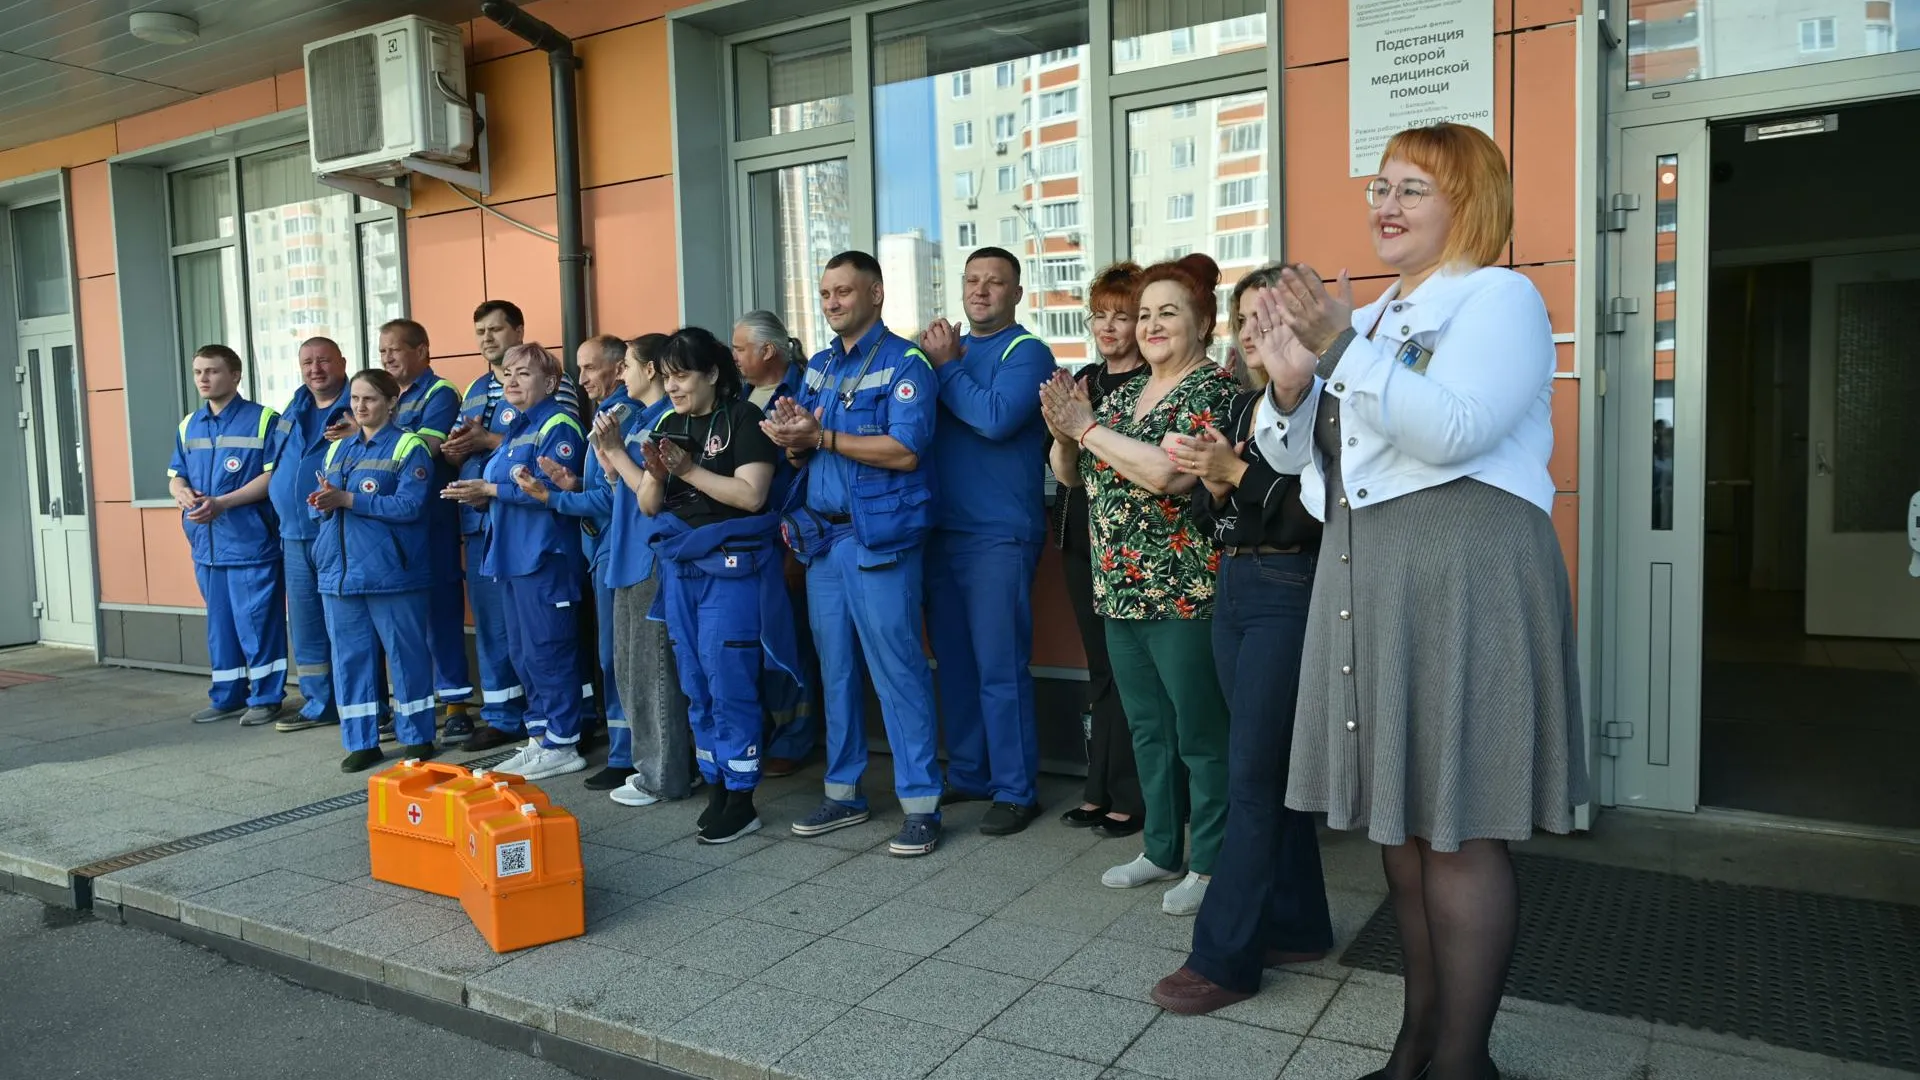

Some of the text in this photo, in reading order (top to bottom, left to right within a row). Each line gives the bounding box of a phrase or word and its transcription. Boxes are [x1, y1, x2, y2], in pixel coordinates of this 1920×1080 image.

[1376, 29, 1464, 52] Подстанция
[1393, 46, 1445, 66] скорой
[1371, 60, 1470, 86] медицинской
[1390, 82, 1450, 99] помощи
[1407, 110, 1489, 128] КРУГЛОСУТОЧНО
